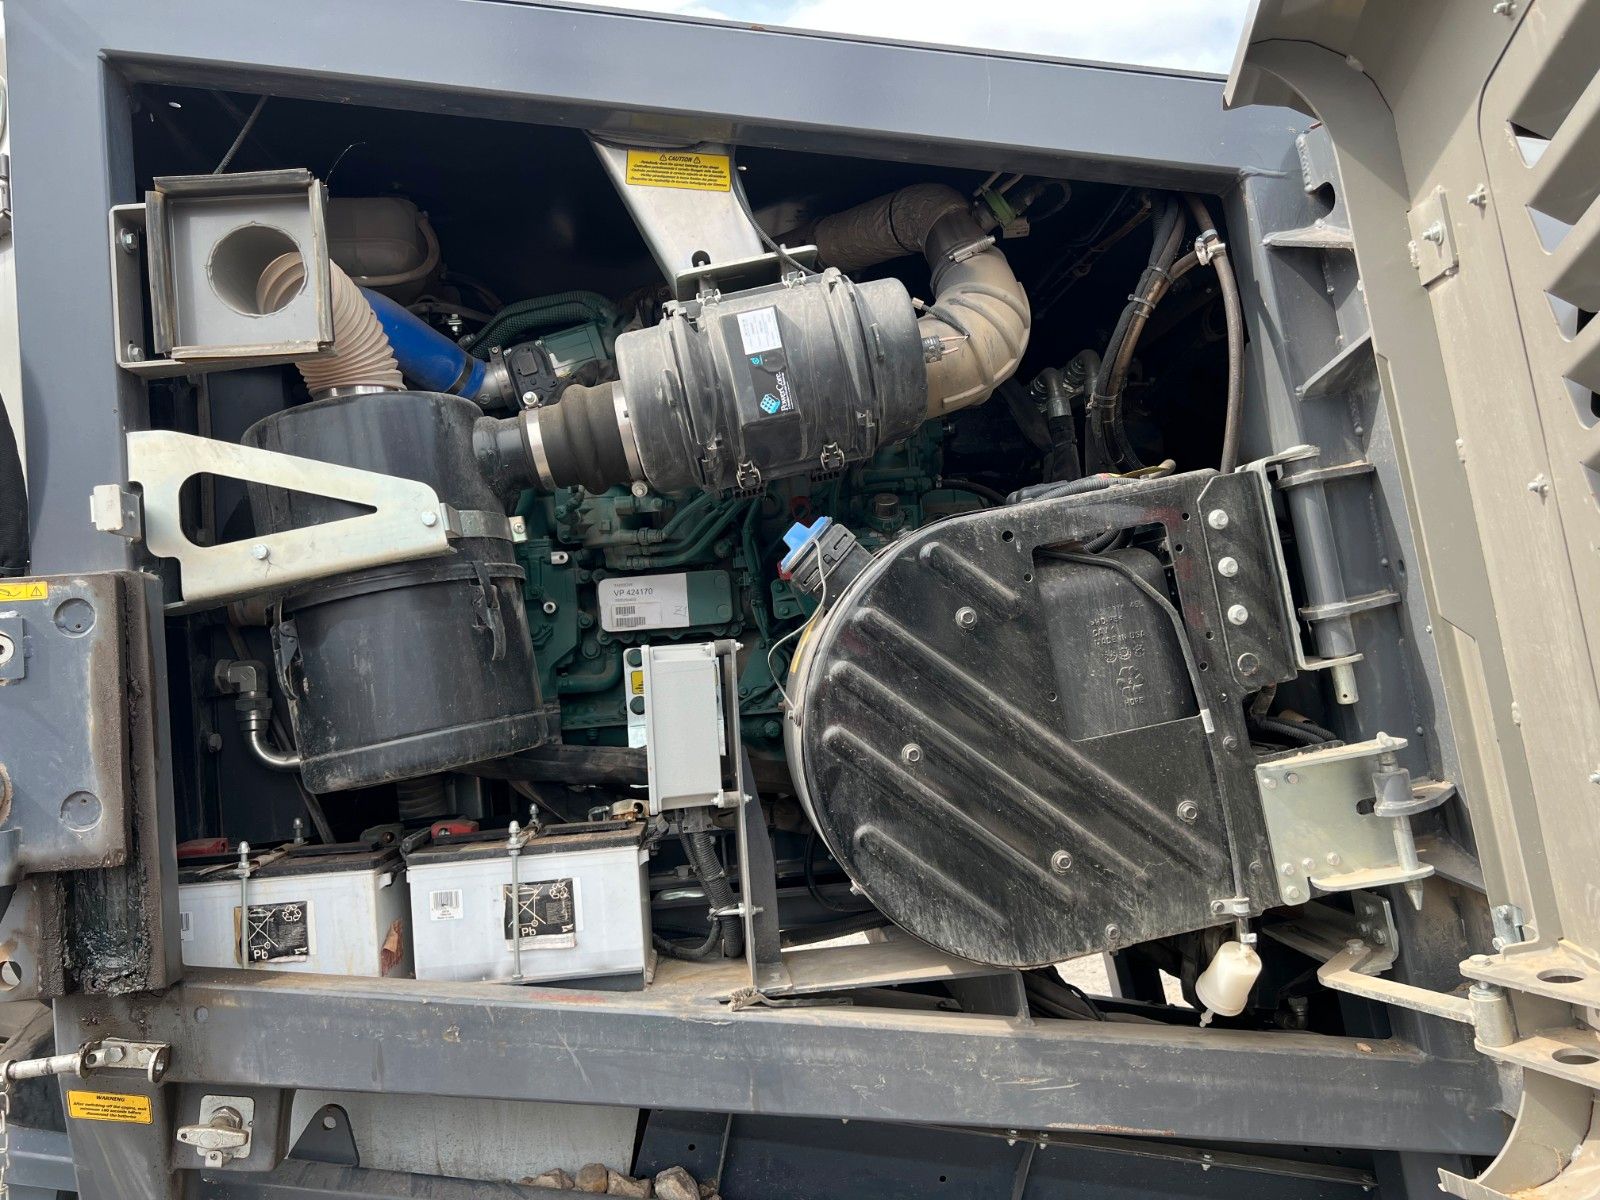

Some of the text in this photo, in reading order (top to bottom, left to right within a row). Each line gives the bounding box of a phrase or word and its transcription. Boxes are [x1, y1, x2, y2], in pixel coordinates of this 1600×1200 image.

[614, 587, 653, 596] VP 424170
[1094, 630, 1145, 646] MADE IN USA
[521, 927, 537, 937] Pb
[253, 949, 269, 960] Pb
